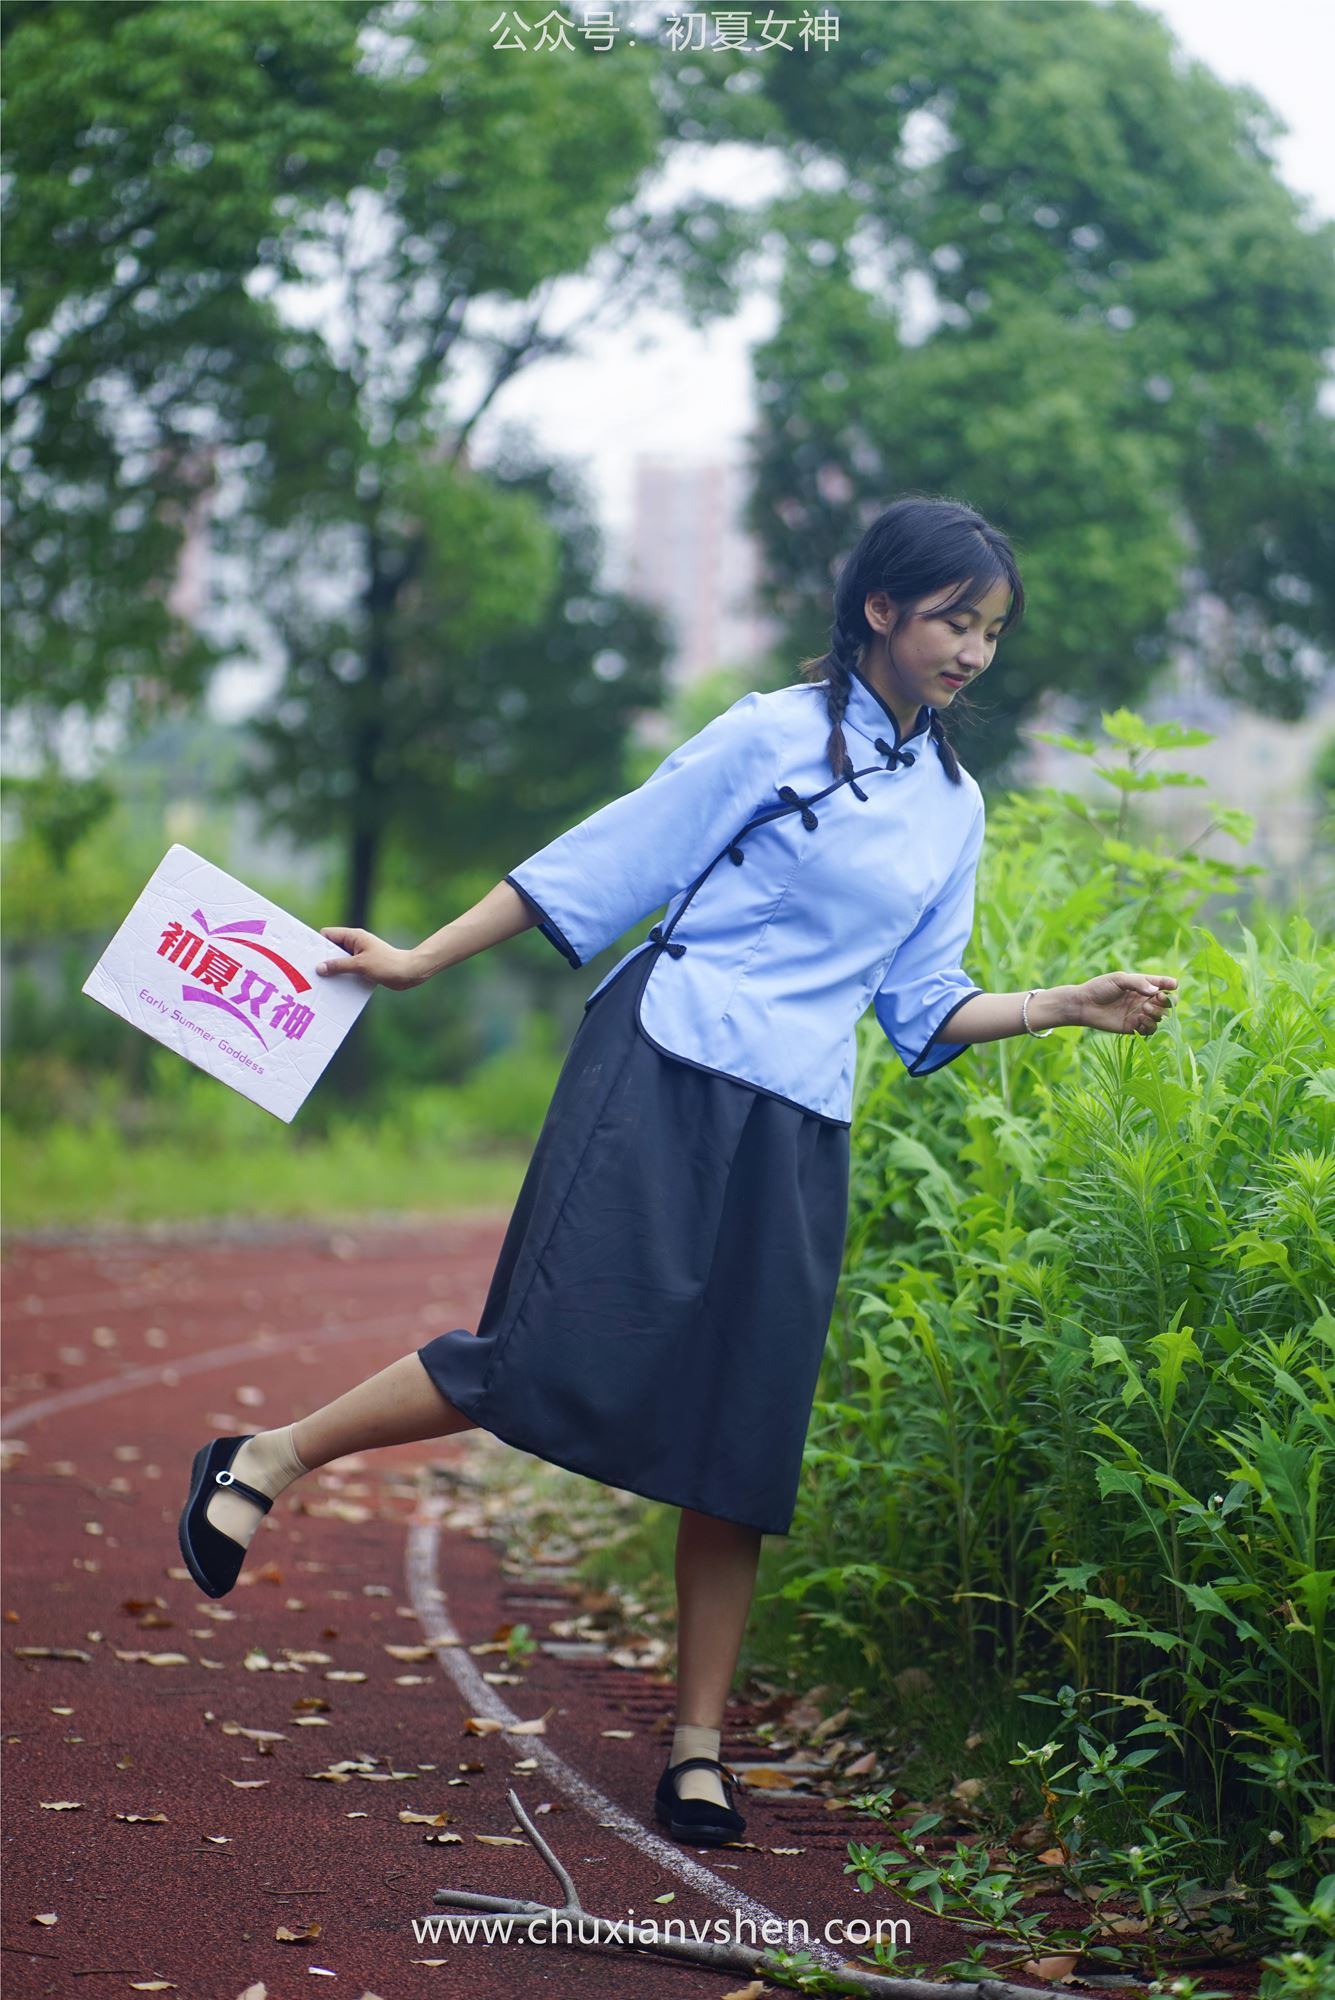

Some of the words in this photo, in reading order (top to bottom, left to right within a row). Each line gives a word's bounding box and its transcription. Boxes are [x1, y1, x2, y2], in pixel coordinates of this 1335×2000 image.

[138, 988, 170, 1014] Early
[170, 1009, 215, 1043] Summer
[217, 1039, 265, 1075] Goddess
[156, 921, 316, 1041] 初夏女神
